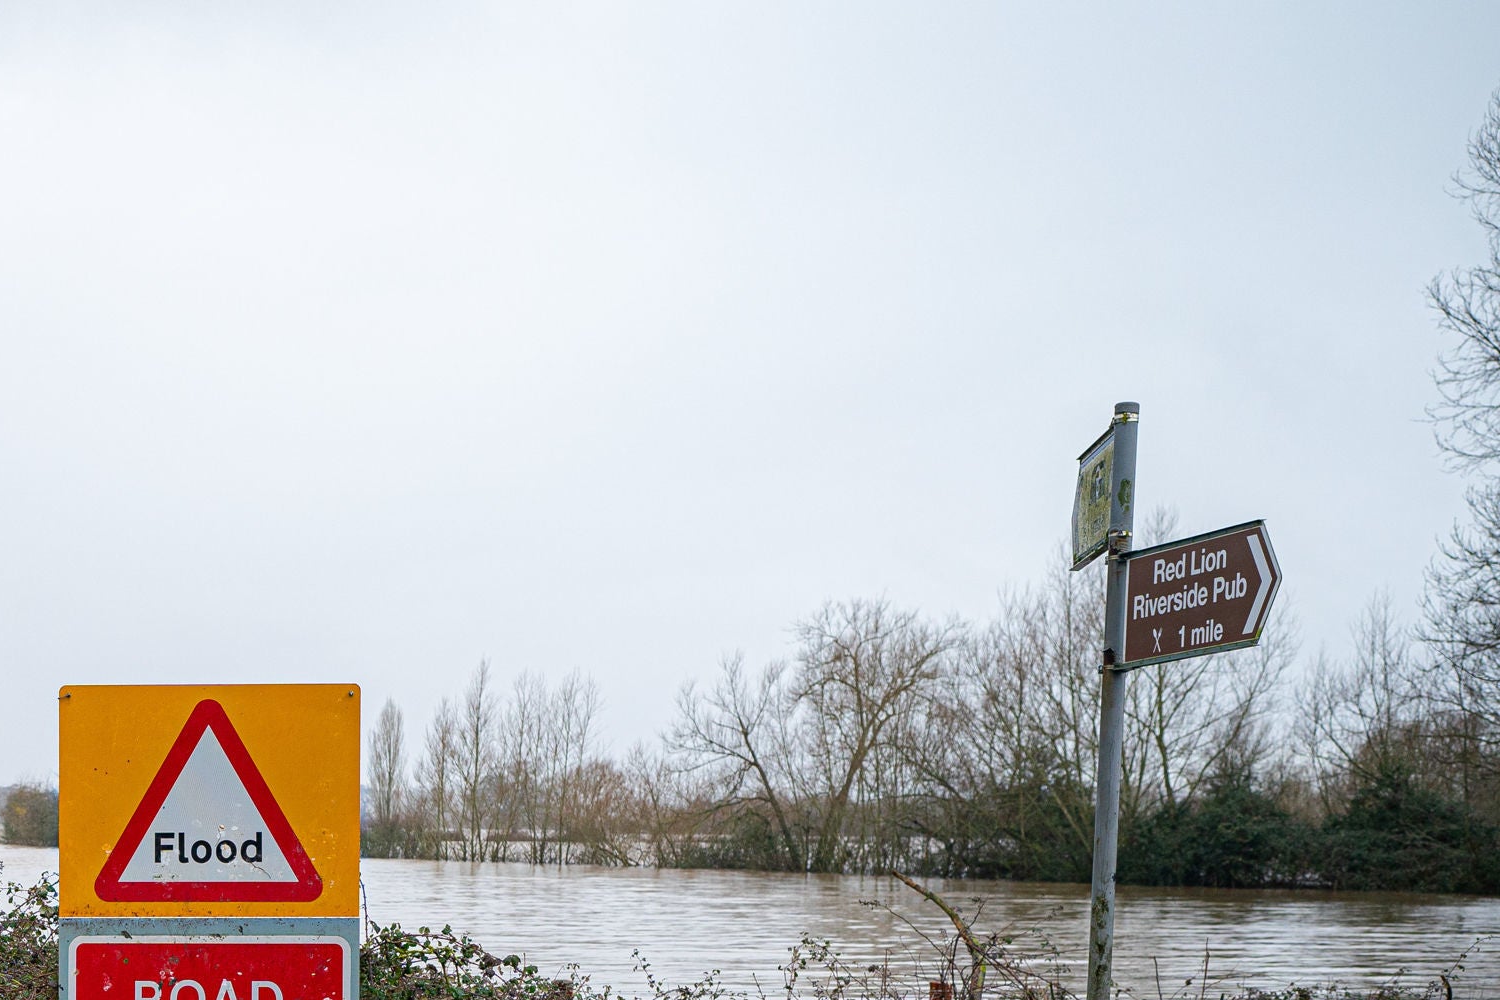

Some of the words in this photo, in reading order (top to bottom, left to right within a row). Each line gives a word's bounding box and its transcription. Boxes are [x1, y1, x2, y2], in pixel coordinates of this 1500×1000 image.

[1153, 552, 1187, 585] Red
[1190, 548, 1227, 576] Lion
[1133, 581, 1208, 621] Riverside
[1212, 572, 1248, 603] Pub
[1178, 625, 1186, 648] 1
[1190, 619, 1224, 646] mile
[153, 831, 264, 864] Flood
